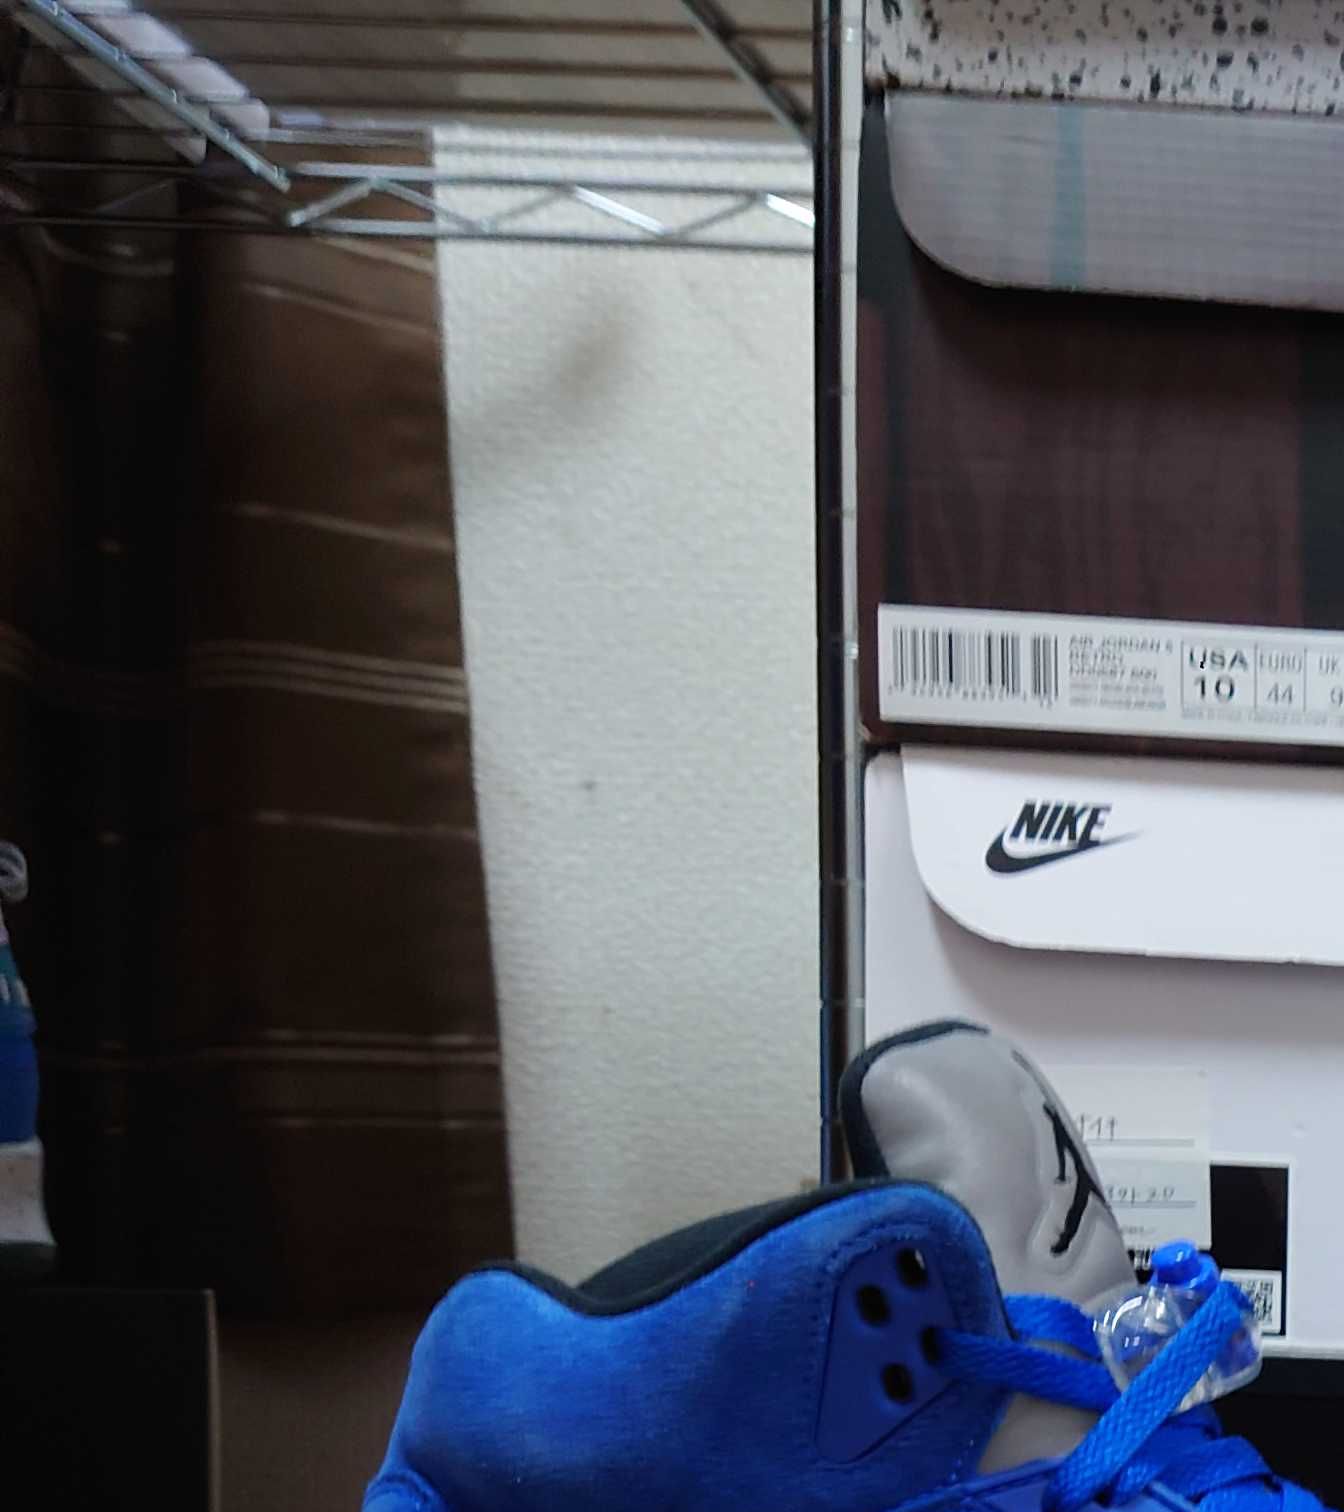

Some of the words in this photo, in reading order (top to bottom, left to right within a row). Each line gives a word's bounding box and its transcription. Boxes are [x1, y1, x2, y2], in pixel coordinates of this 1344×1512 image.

[1189, 647, 1248, 672] USA
[1193, 676, 1236, 701] 10
[1266, 682, 1294, 706] 44
[1009, 802, 1113, 850] NIKE
